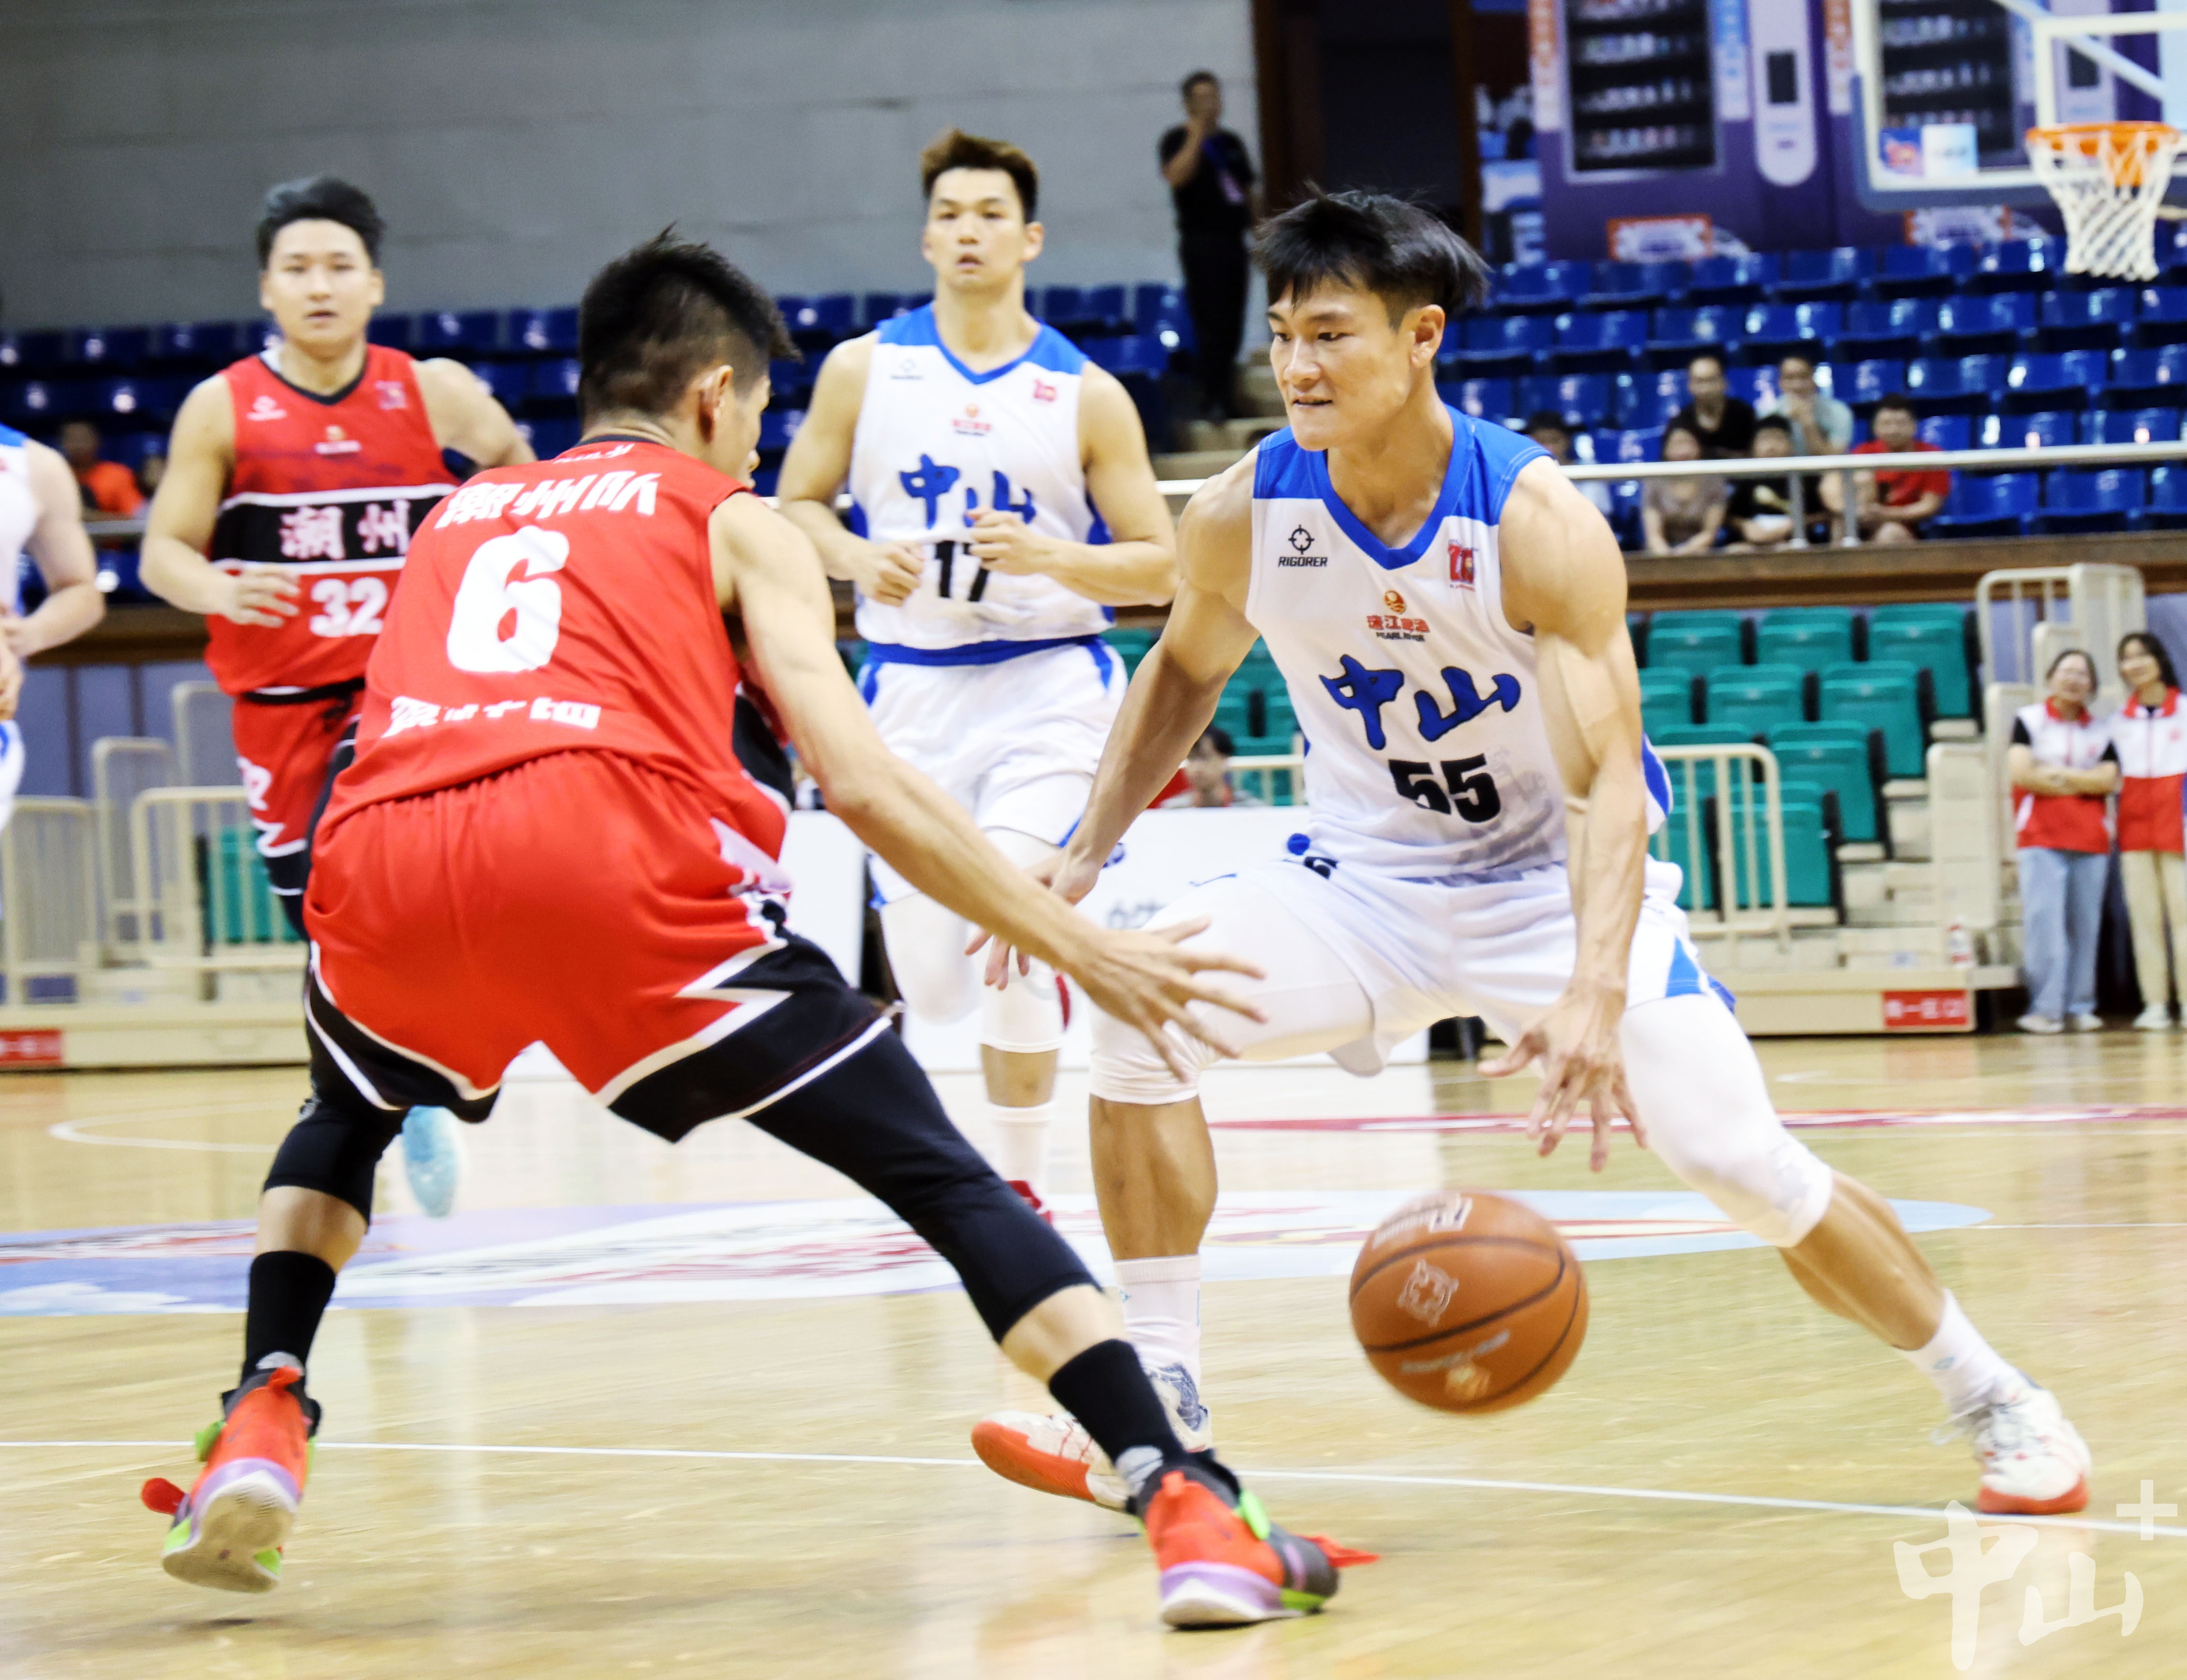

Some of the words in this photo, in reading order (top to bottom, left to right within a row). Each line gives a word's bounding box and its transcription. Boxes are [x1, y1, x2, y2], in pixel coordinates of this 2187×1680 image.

[900, 454, 1036, 530] 中山
[280, 499, 411, 560] 潮州
[1278, 556, 1328, 567] RIGORER
[310, 577, 387, 638] 32
[447, 525, 570, 673] 6
[1319, 654, 1521, 750] 中山
[1388, 753, 1501, 823] 55
